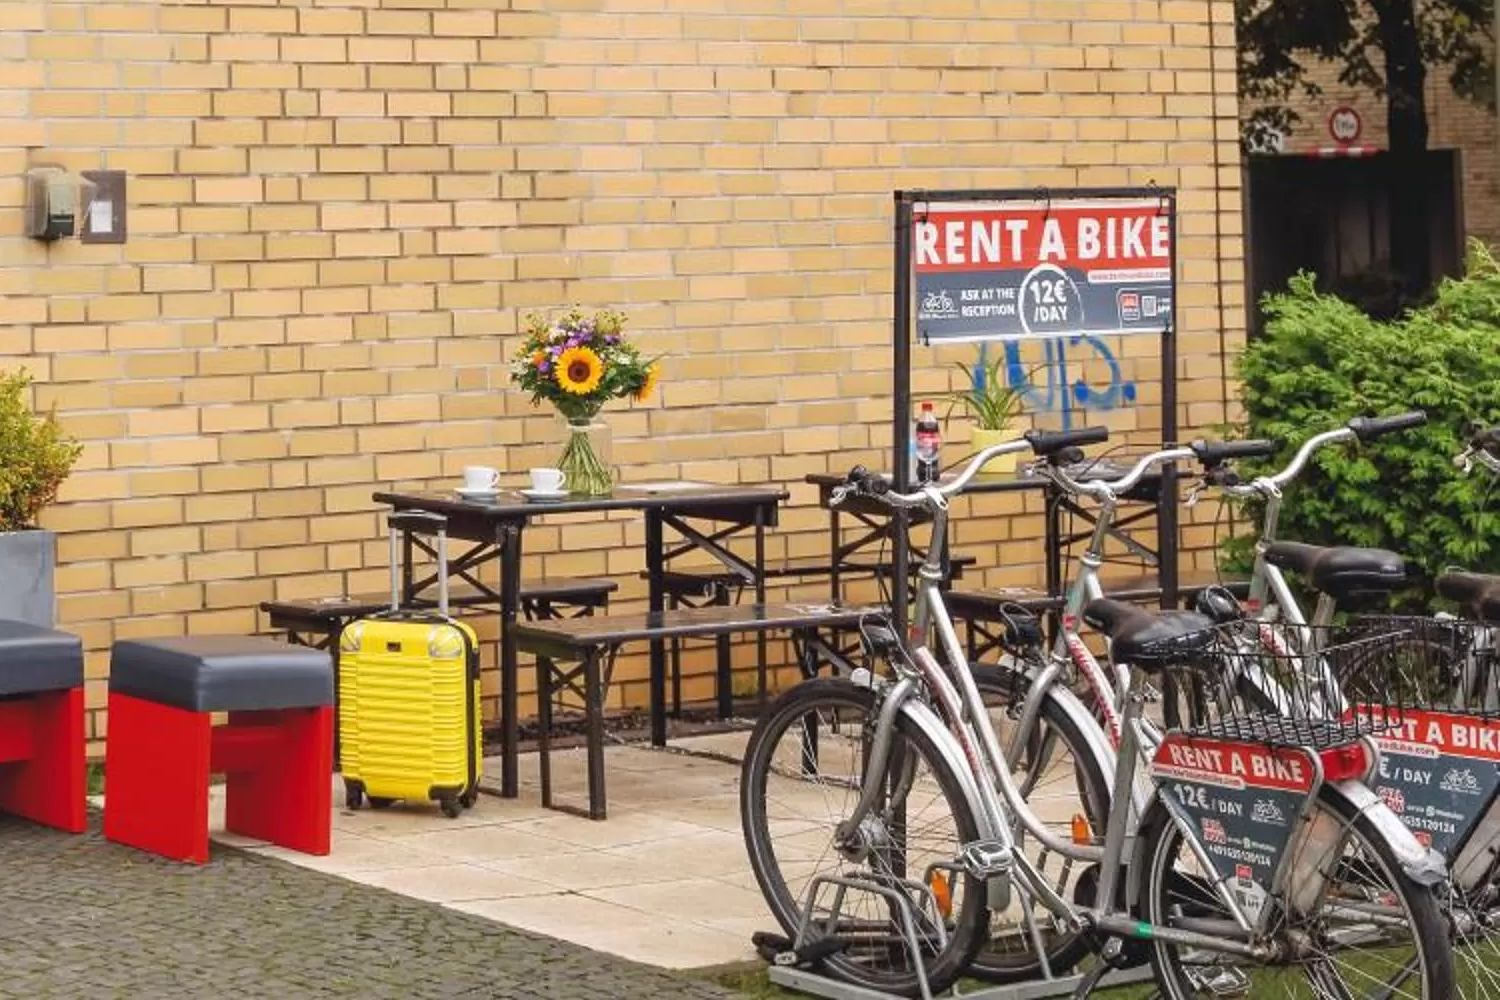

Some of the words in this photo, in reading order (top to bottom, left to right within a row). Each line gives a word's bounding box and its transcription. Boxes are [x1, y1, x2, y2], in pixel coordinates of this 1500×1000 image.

[915, 218, 1029, 265] RENT
[1039, 217, 1069, 261] A
[1077, 215, 1170, 260] BIKE
[961, 289, 980, 300] ASK
[981, 288, 995, 300] AT
[996, 287, 1015, 299] THE
[1029, 279, 1067, 303] 12€
[961, 303, 1015, 317] RECEPTION
[1425, 721, 1445, 745] A
[1452, 723, 1500, 752] BIK
[1168, 743, 1224, 773] RENT
[1231, 752, 1249, 776] A
[1250, 755, 1305, 783] BIKE
[1174, 783, 1210, 809] 12€
